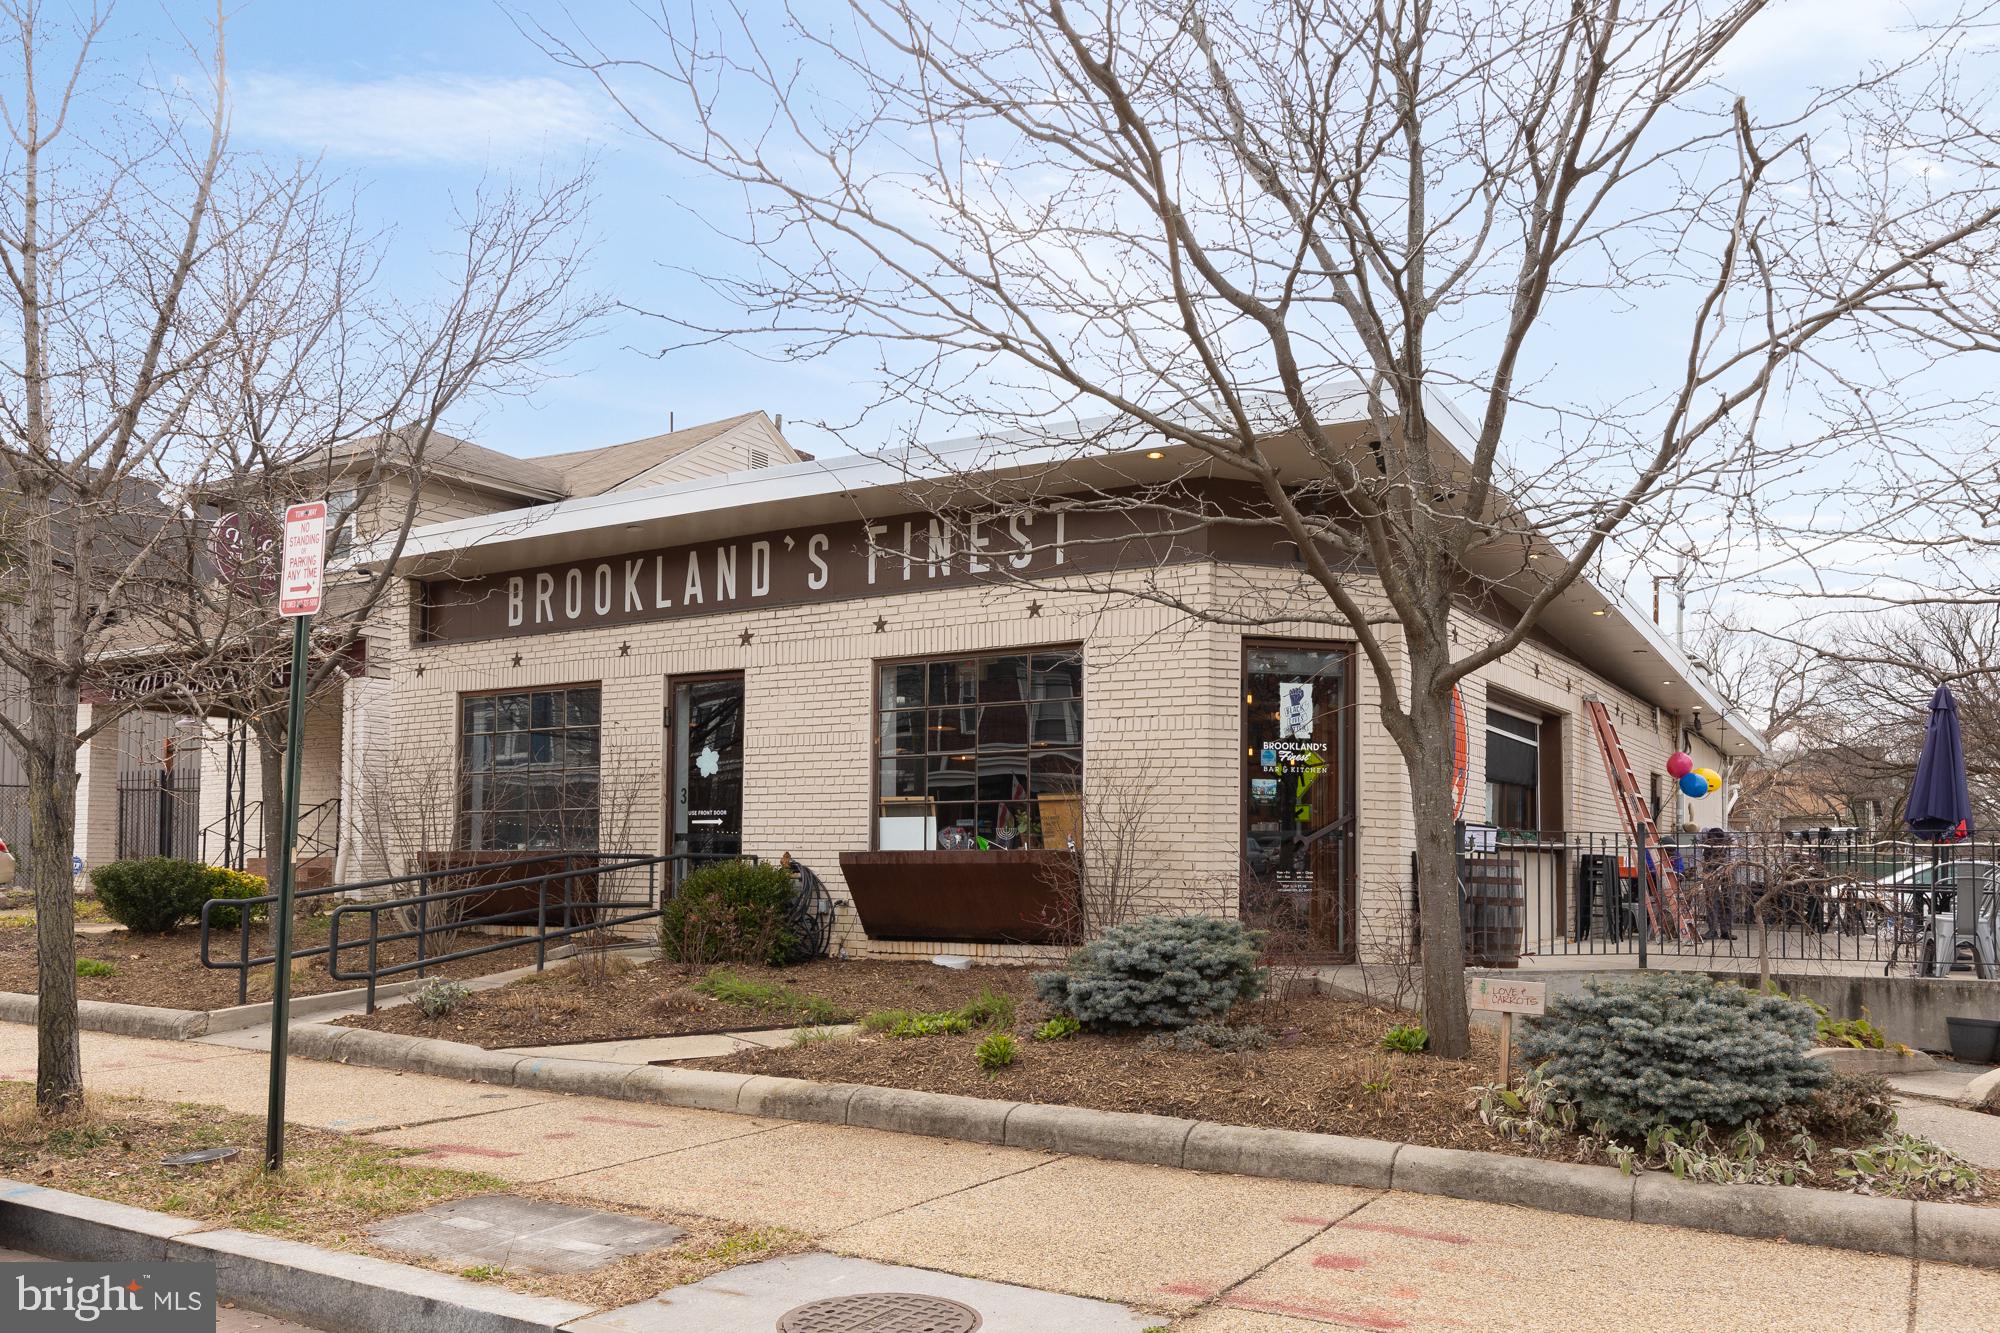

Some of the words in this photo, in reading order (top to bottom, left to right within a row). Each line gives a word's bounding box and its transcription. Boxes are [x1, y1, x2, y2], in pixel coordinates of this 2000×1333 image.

[300, 522, 310, 533] NO
[289, 533, 320, 547] STANDING
[289, 554, 317, 568] PARKING
[508, 533, 829, 627] BROOKLAND'S
[868, 501, 1072, 585] FINEST
[287, 569, 301, 581] ANY
[304, 567, 318, 579] TIME
[1263, 742, 1328, 751] BROOKLAND'S
[1278, 750, 1312, 762] Finest
[1290, 766, 1328, 774] KITCHEN
[680, 788, 687, 805] 3
[1492, 986, 1518, 997] LOVE
[1491, 995, 1539, 1006] CARROTS
